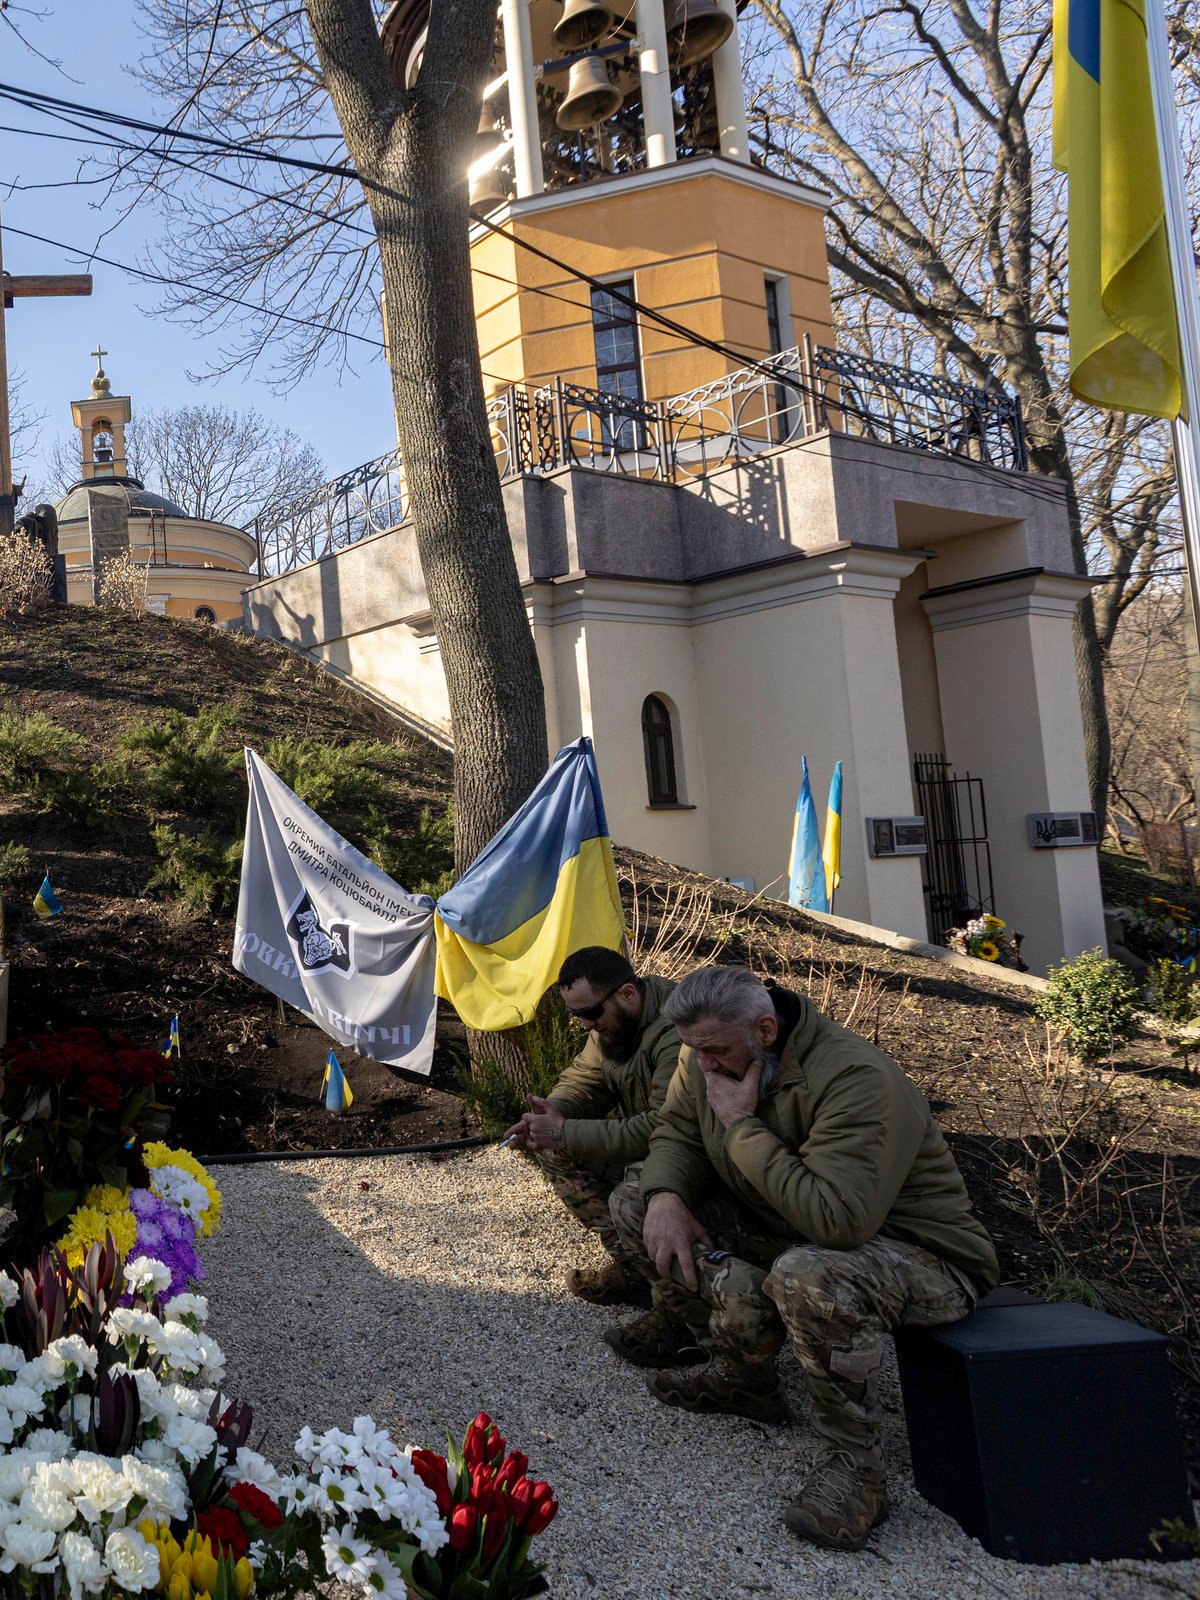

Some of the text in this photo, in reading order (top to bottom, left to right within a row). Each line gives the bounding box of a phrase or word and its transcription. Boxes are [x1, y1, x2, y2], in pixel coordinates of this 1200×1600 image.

[283, 817, 417, 917] ОКРЕМИЙ БАТАЛЬЙОН ІМЕН
[288, 840, 397, 923] ДМИТРА КОЦЮБАЙЛА
